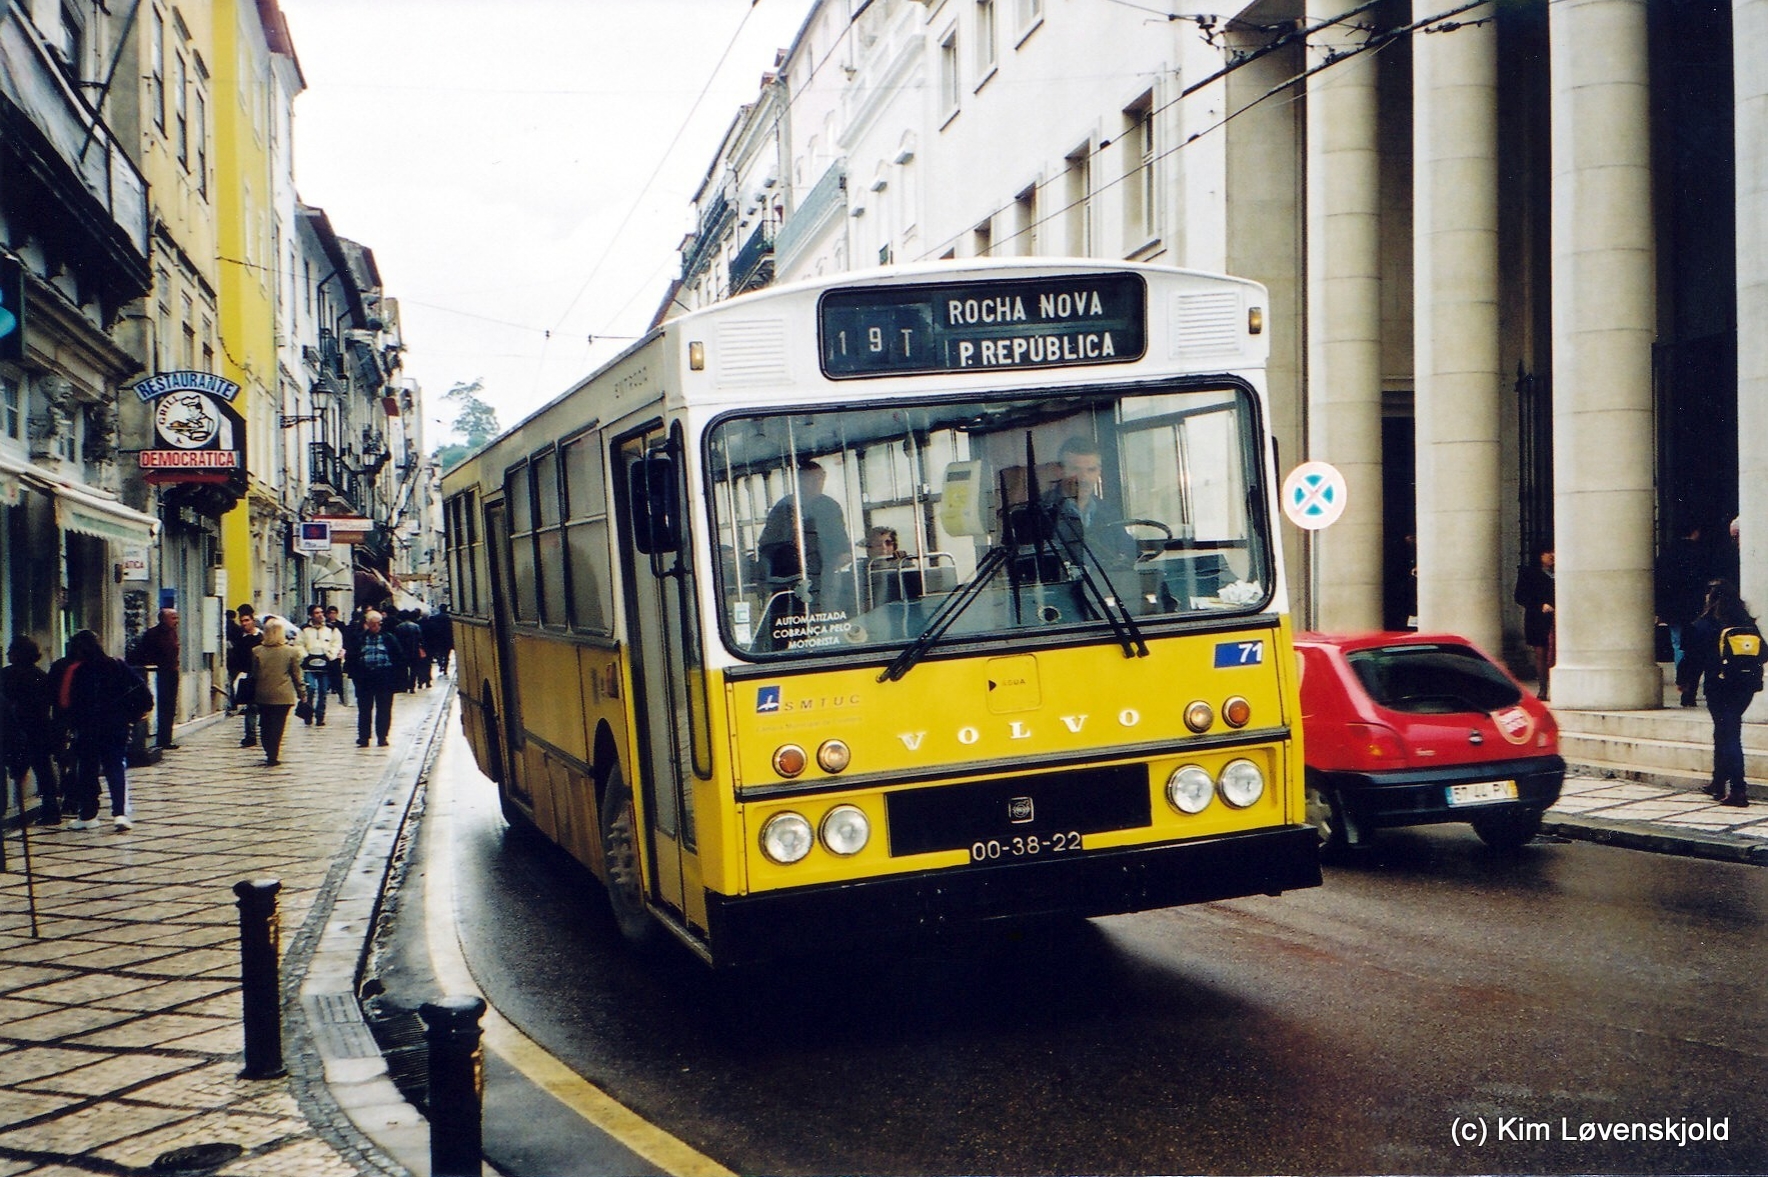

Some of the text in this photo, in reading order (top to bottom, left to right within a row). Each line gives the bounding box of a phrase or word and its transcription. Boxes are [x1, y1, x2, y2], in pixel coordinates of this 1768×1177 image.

[949, 291, 1102, 325] ROCHA NOVA
[981, 332, 1115, 366] REPÚBLICA
[137, 373, 236, 398] RESTAURANTE
[158, 396, 180, 425] GRILL
[773, 622, 852, 639] COBRANÇA PELO
[775, 611, 847, 627] AUTOMATIZADA
[788, 636, 840, 649] MOTORISTA
[1238, 642, 1263, 663] 71
[898, 709, 1140, 751] VOLVO
[972, 831, 1081, 861] 00-38-22
